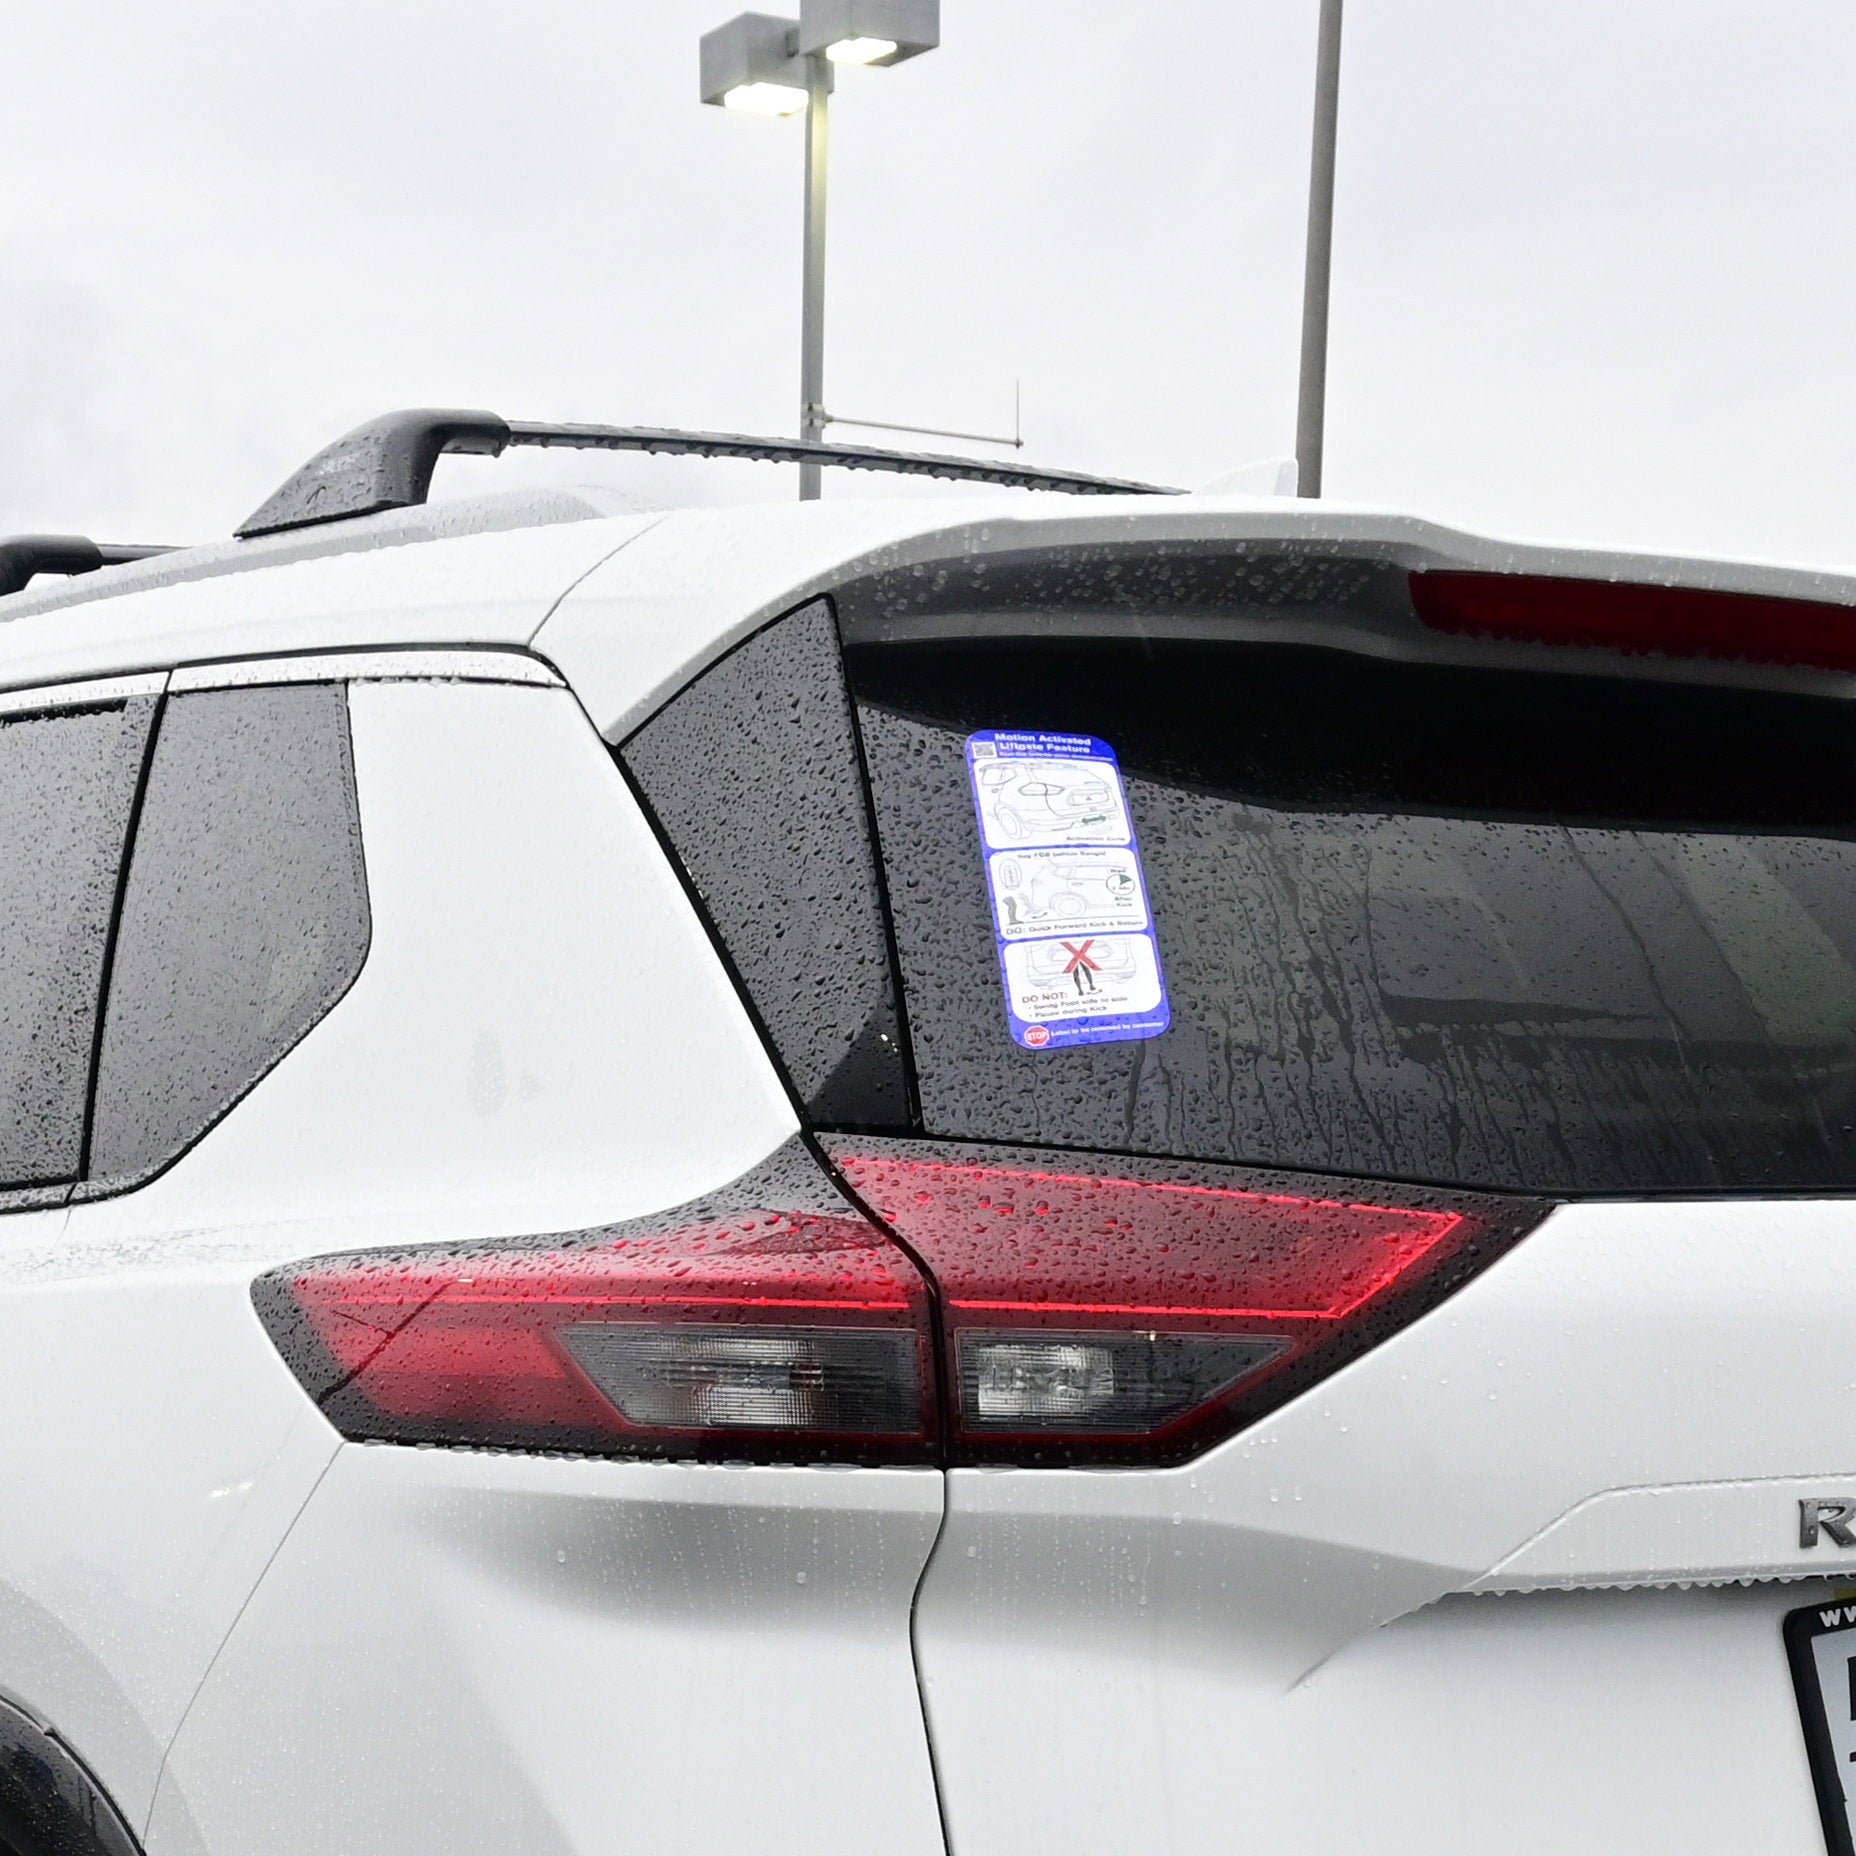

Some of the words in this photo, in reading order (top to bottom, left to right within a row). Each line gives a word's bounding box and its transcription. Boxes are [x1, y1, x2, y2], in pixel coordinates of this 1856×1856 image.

[995, 733, 1035, 742] Motion
[1039, 735, 1091, 746] Activated
[1000, 742, 1044, 751] Liftgate
[1047, 743, 1090, 753] Feature
[1042, 991, 1068, 1001] NOT:
[1026, 1030, 1048, 1041] STOP
